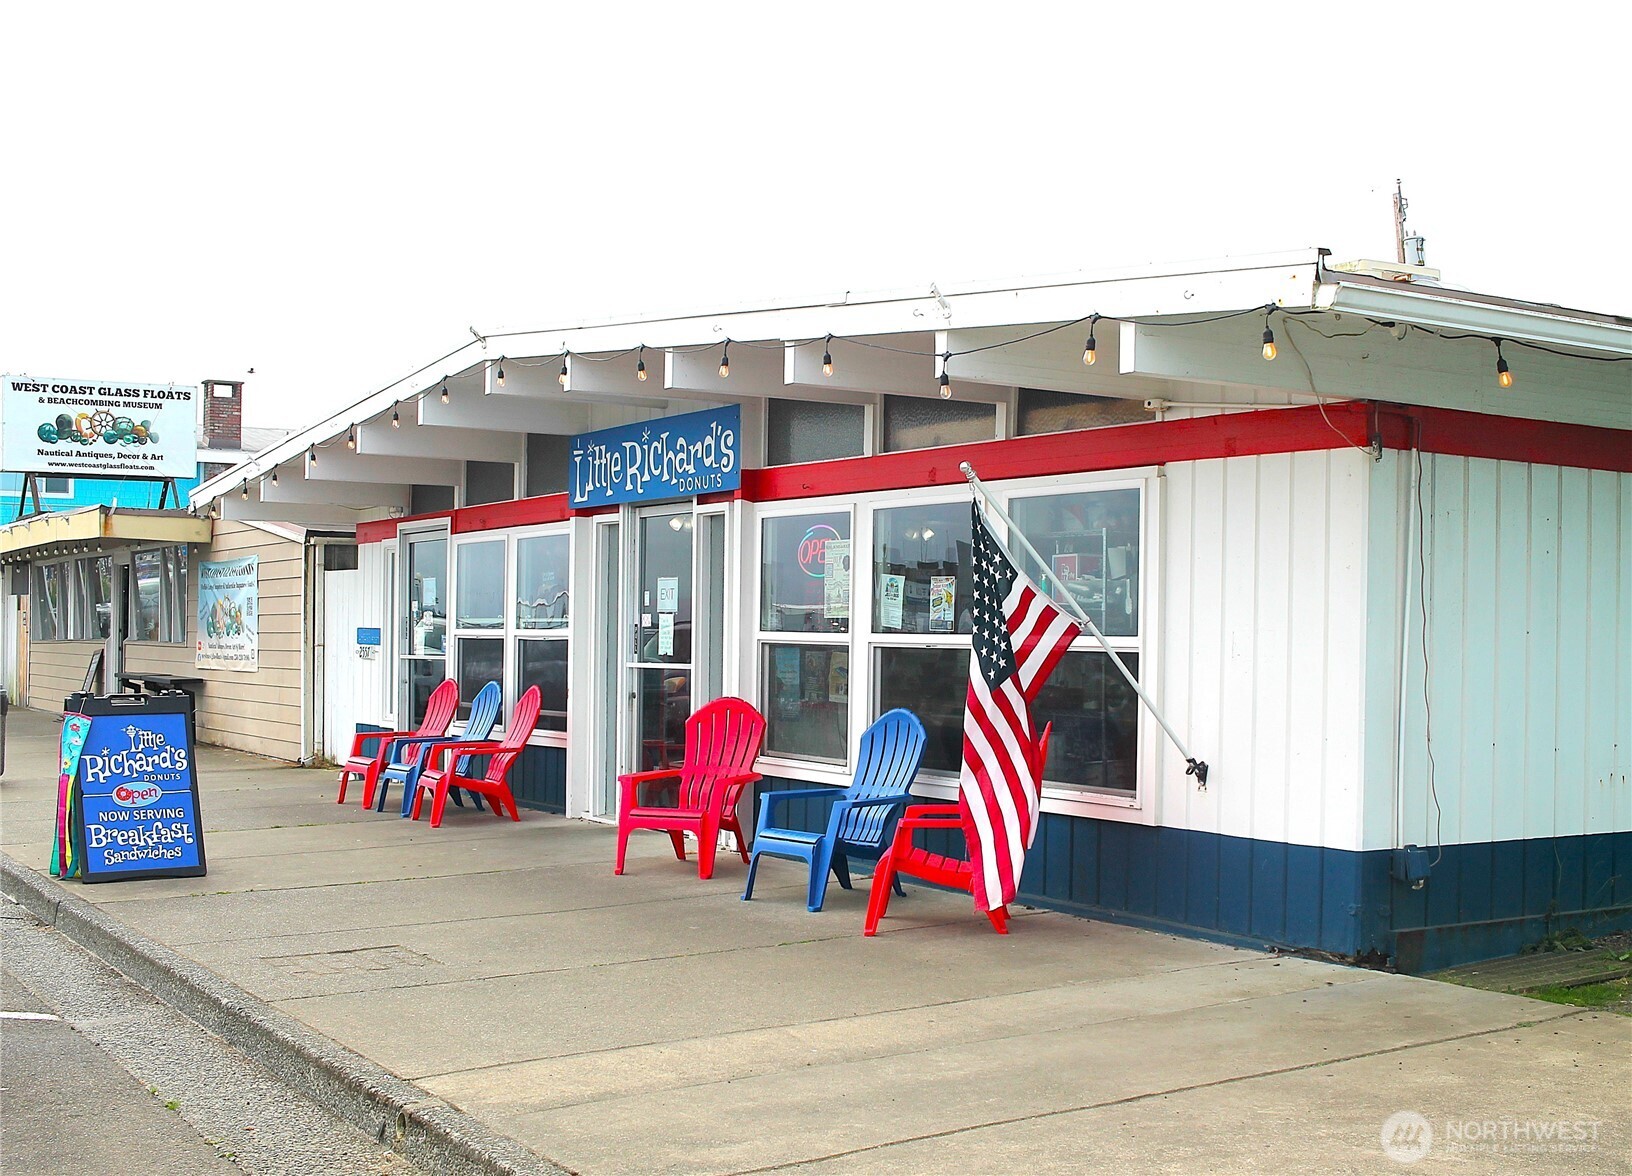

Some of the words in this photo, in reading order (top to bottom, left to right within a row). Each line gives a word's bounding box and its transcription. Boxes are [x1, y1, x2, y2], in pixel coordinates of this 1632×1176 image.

[11, 382, 49, 393] WEST
[51, 385, 96, 396] COAST
[97, 387, 141, 398] GLASS
[142, 388, 192, 401] FLOATS
[47, 397, 121, 408] BEACHCOMBING
[122, 400, 163, 410] MUSEUM
[36, 448, 74, 458] Nautical
[75, 451, 116, 460] Antiques,
[117, 453, 140, 461] Decor
[150, 453, 164, 461] Art
[574, 446, 623, 503] Little
[622, 421, 735, 495] Richard's
[47, 461, 155, 471] www.westcoastglassfloats.com
[678, 473, 722, 493] DONUTS
[799, 539, 831, 564] OPE
[660, 587, 675, 600] EXIT
[130, 729, 166, 752] Little
[81, 746, 188, 783] Richard's
[144, 773, 181, 781] DONUTS
[115, 786, 158, 804] Open
[99, 811, 130, 821] NOW
[133, 808, 184, 820] SERVING
[86, 822, 194, 848] Breakfast
[104, 844, 182, 866] Sandwiches
